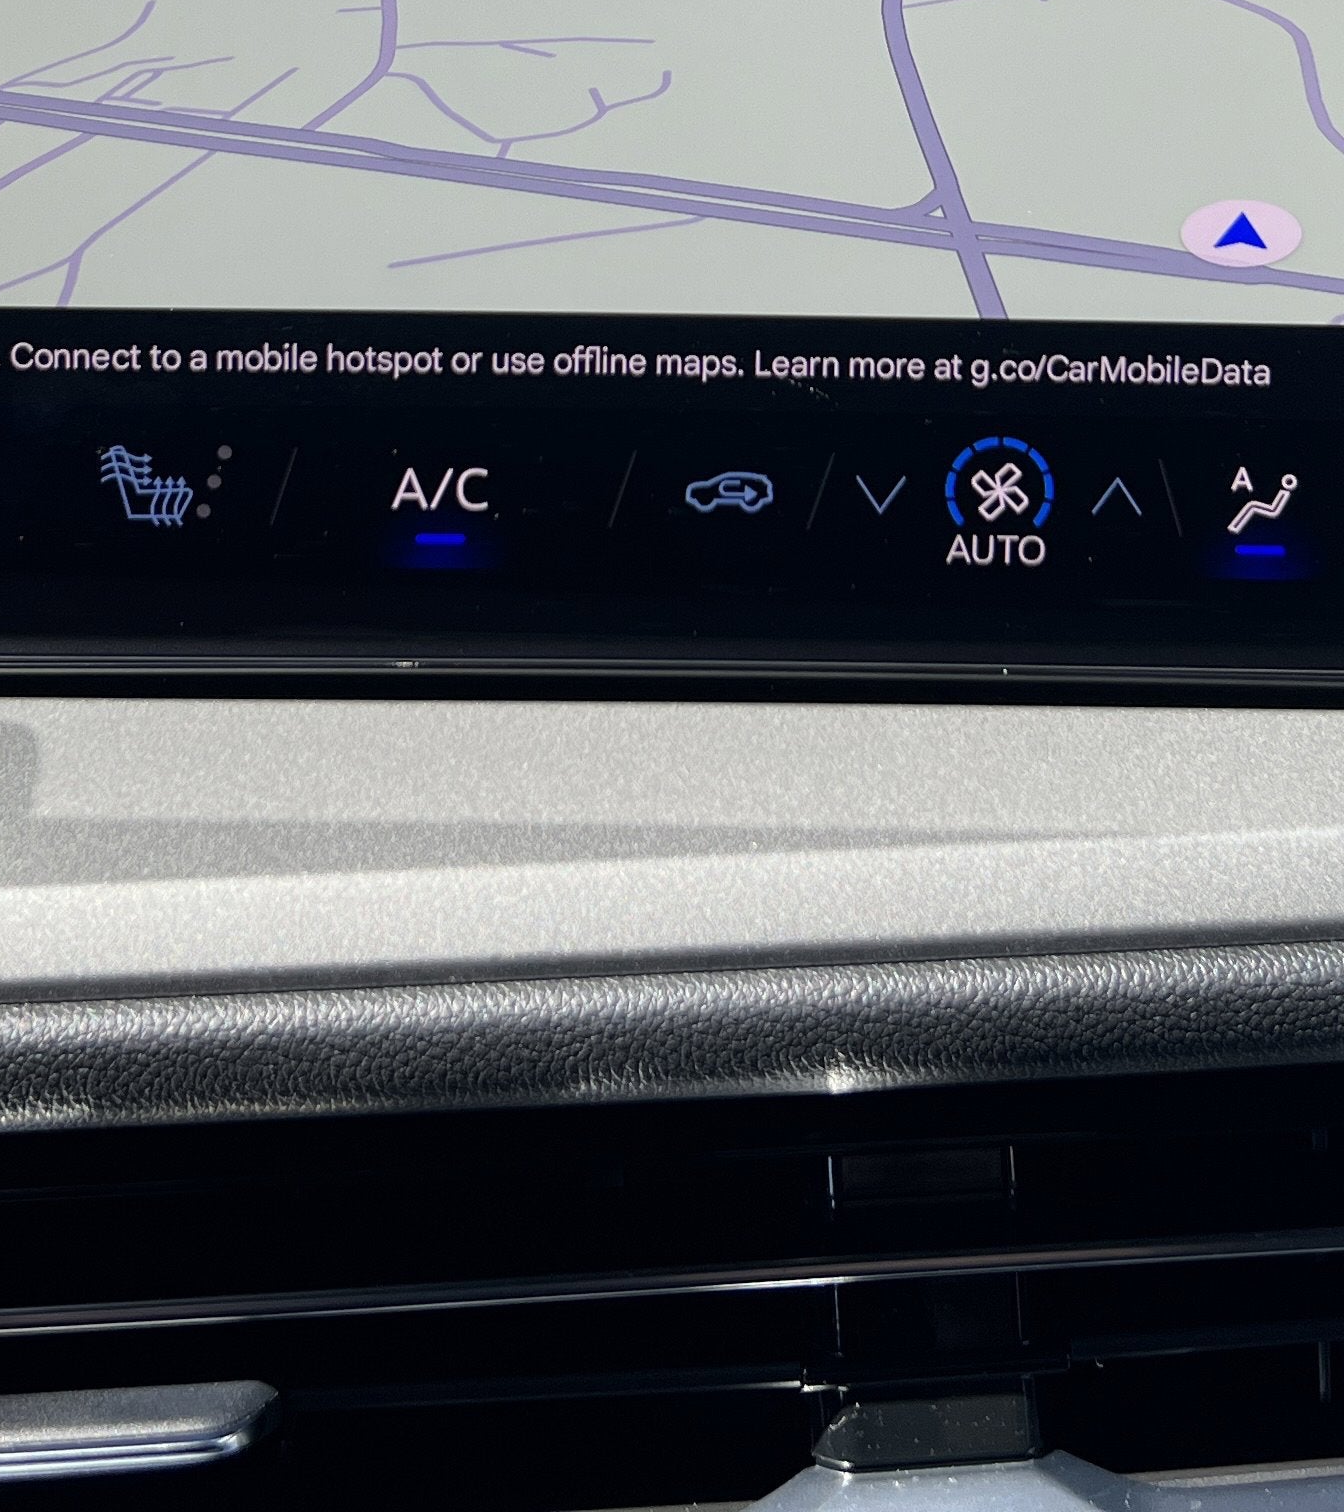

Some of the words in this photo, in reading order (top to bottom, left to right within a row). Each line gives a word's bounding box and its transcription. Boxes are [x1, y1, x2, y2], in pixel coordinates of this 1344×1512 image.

[10, 340, 142, 372] Connect
[149, 343, 182, 372] to
[189, 348, 208, 373] a
[216, 341, 318, 374] mobile
[326, 342, 444, 380] hotspot
[451, 351, 484, 375] or
[491, 351, 546, 376] use
[553, 344, 647, 376] offline
[655, 352, 744, 384] maps.
[754, 348, 840, 380] Learn
[848, 355, 926, 381] more
[933, 353, 963, 382] at
[970, 352, 1271, 389] g.co/CarMobileData
[391, 466, 489, 512] A/C
[945, 533, 1046, 566] AUTO
